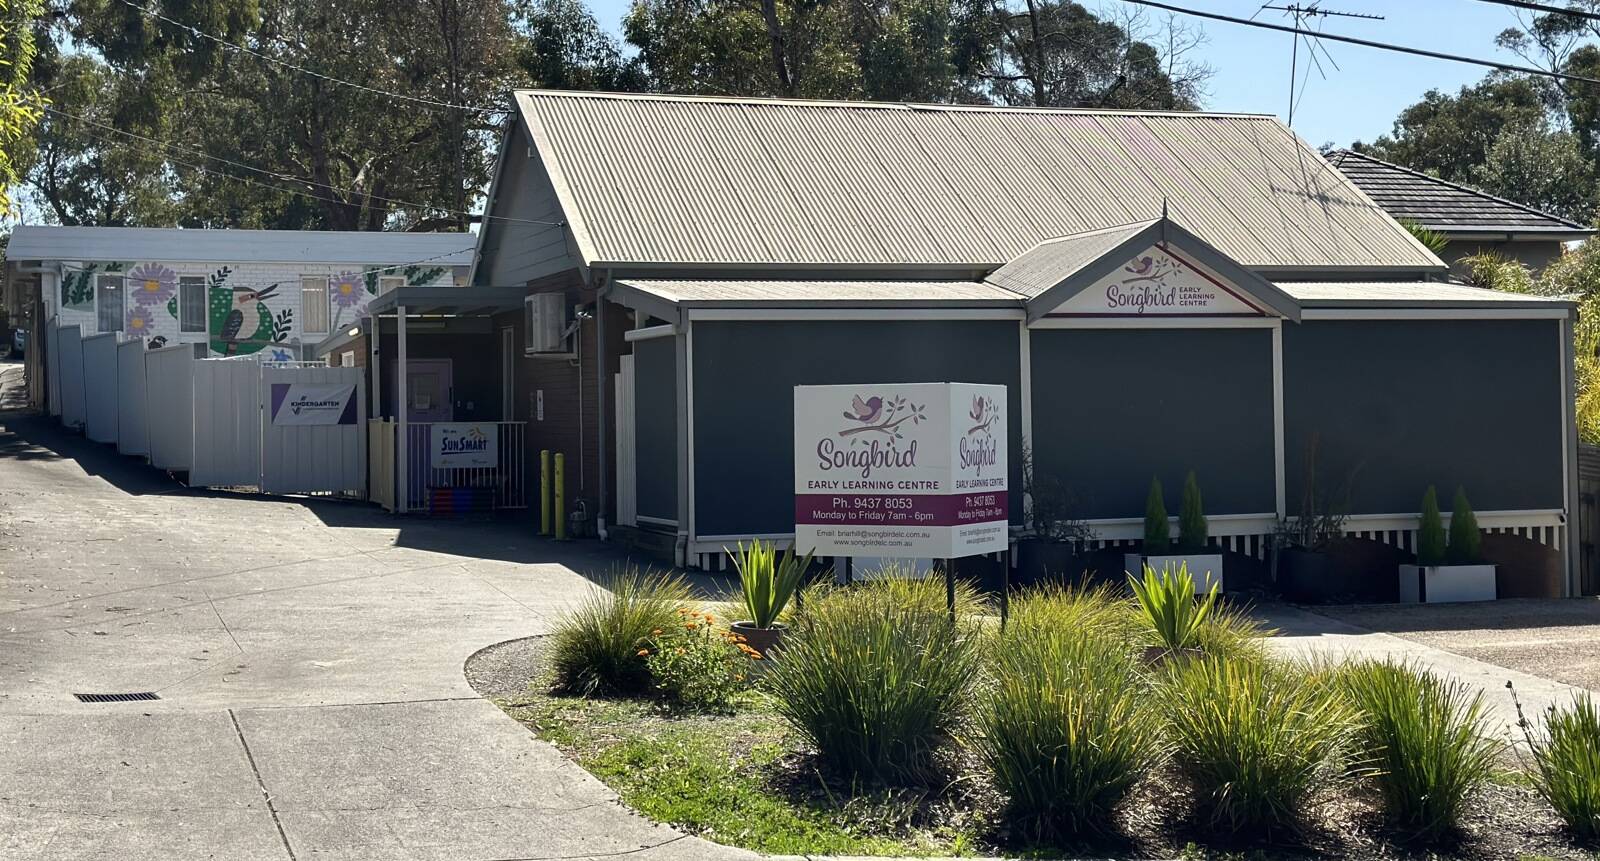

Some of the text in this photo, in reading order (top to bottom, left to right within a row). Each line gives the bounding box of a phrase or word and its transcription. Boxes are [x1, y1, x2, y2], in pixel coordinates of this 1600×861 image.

[1106, 285, 1176, 313] Songbird
[817, 438, 918, 479] Songbird
[959, 437, 997, 476] Songbird
[808, 480, 940, 490] EARLY LEARNING CENTRE
[956, 478, 1004, 489] EARLY LEARNING CENTRE
[833, 498, 913, 509] Ph. 9437 8053
[813, 511, 847, 522] Monday
[848, 511, 857, 519] to
[859, 511, 886, 522] Friday
[887, 512, 907, 520] 7am
[914, 512, 934, 522] 6pm
[834, 539, 913, 547] www.songbirdelc.com.au
